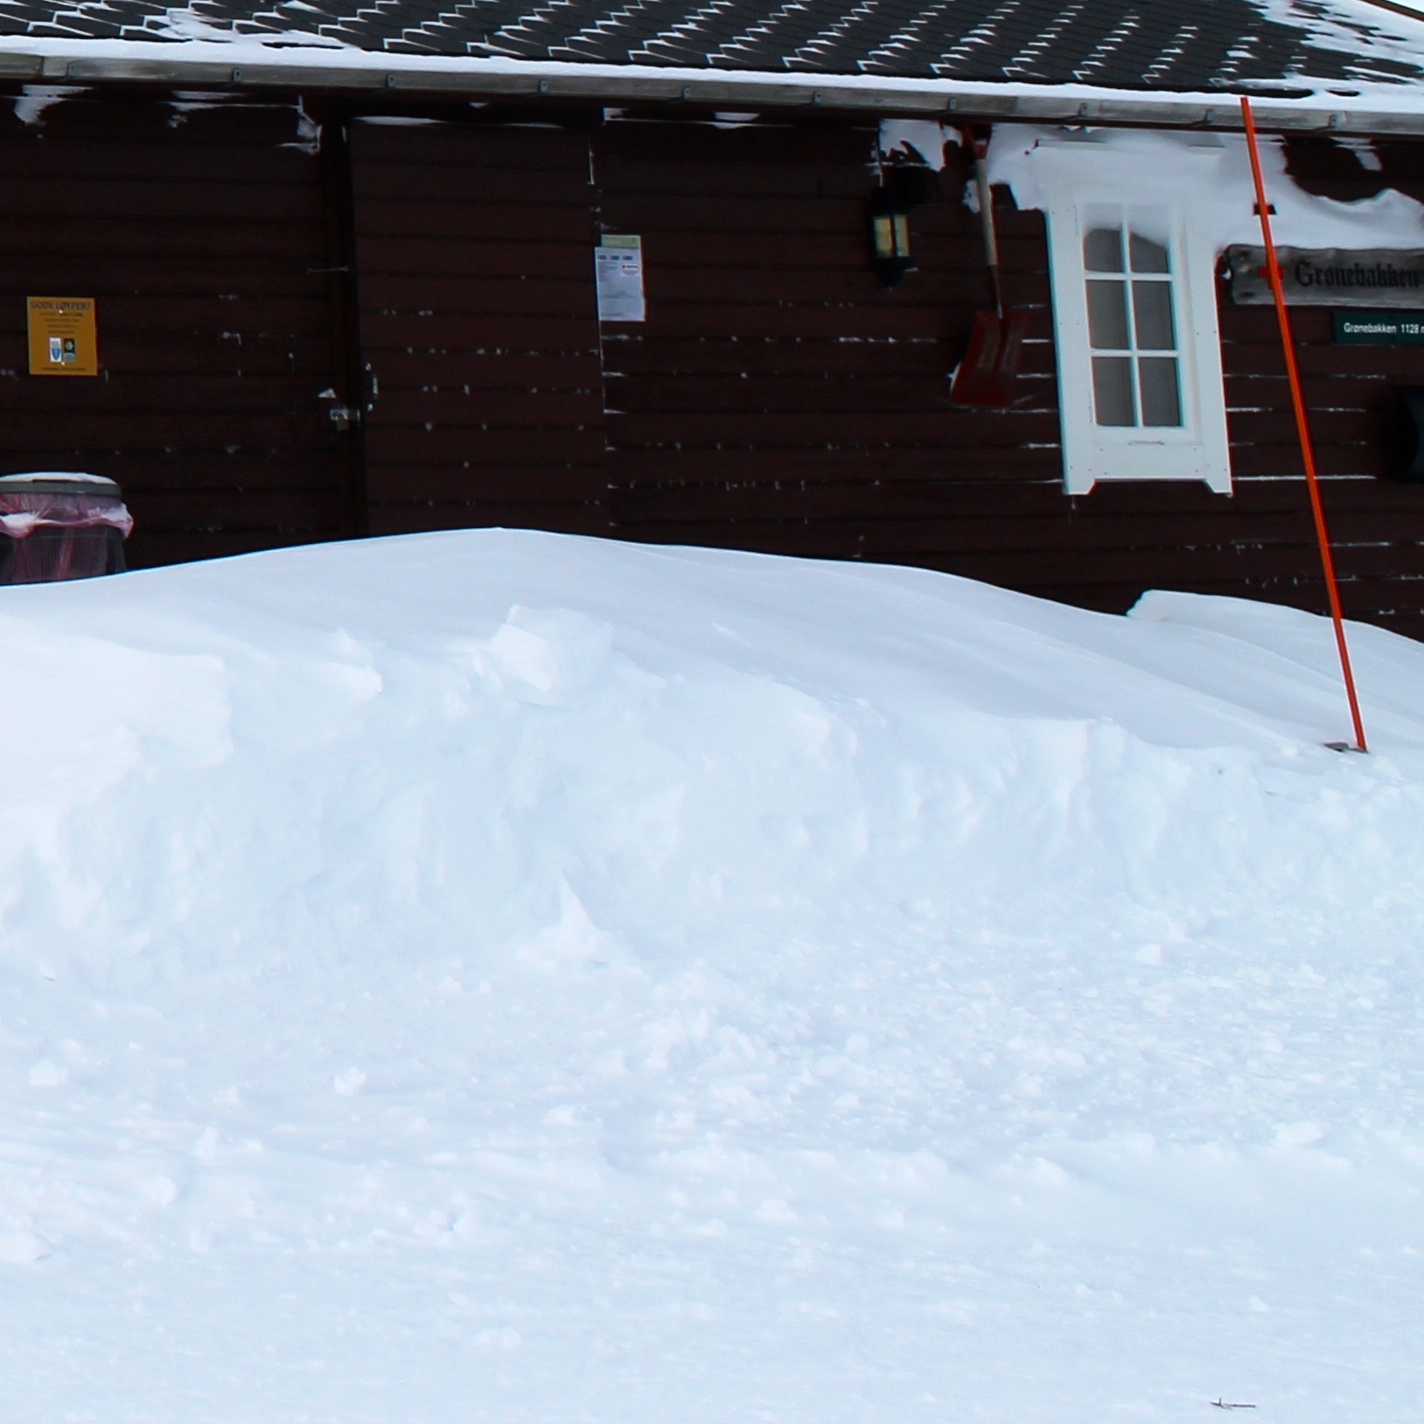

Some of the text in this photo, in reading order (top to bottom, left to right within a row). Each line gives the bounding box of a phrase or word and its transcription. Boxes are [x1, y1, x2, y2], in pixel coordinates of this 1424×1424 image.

[1294, 259, 1420, 289] Grønebakken
[1343, 322, 1398, 334] Grønebakken
[1401, 323, 1420, 334] 1128
